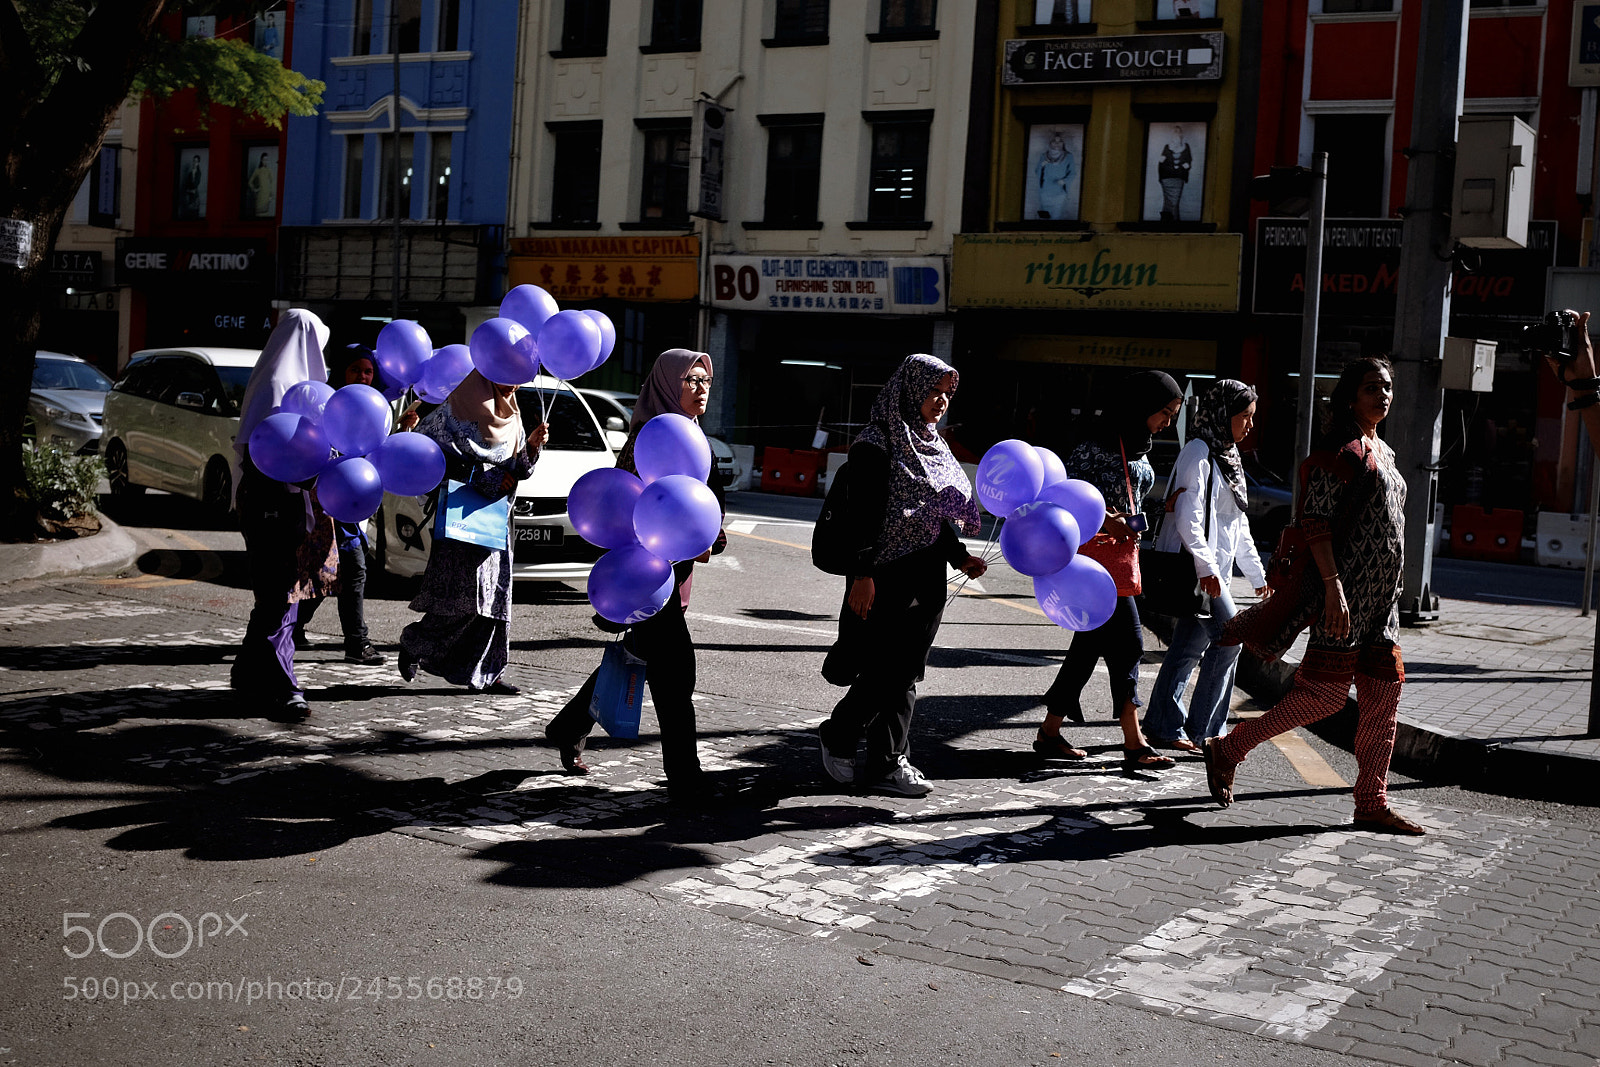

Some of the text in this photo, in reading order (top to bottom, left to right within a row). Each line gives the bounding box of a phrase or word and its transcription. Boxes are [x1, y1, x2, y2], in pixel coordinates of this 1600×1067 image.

[1044, 49, 1183, 70] FACE TOUCH
[1265, 227, 1307, 246] PEMBORON
[560, 238, 628, 255] MAKANAN
[632, 238, 693, 255] CAPITAL
[125, 252, 168, 270] GENE
[762, 259, 803, 277] ALAT-ALAT
[1025, 248, 1158, 287] rimbun
[550, 285, 609, 298] CAPITAL
[714, 264, 760, 301] BO
[776, 280, 828, 294] FURNISHING
[1290, 272, 1368, 293] AKED
[215, 314, 246, 329] GENE
[979, 483, 1005, 502] NISA
